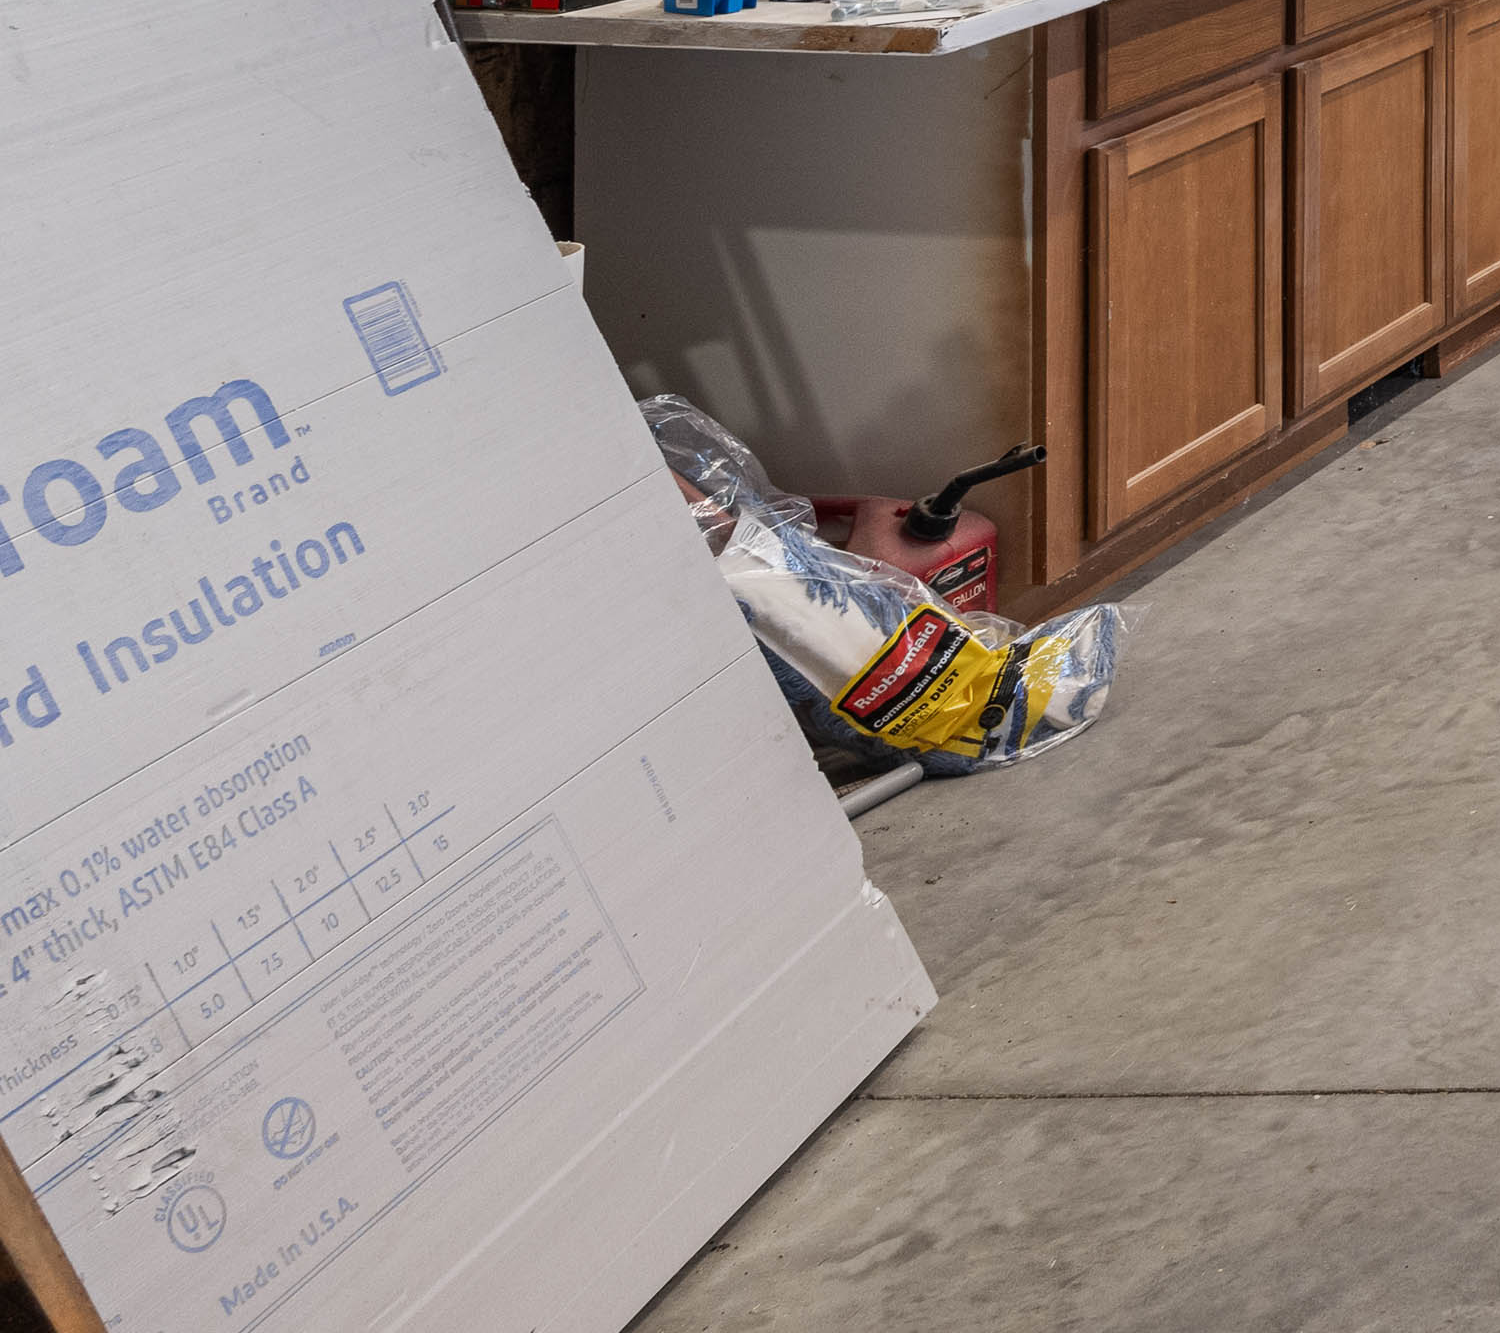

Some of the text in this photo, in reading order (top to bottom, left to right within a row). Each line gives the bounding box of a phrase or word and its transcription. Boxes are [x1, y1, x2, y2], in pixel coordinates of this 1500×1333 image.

[206, 456, 310, 525] Brand
[76, 521, 365, 695] Insulation
[952, 580, 986, 608] GALLON
[854, 621, 937, 710] Rubbermaid
[873, 676, 932, 729] Commercial
[889, 702, 929, 737] BLEND
[932, 669, 960, 702] DUST
[59, 845, 121, 897] 0.1%
[121, 804, 191, 860] water
[193, 734, 311, 817] absorption
[42, 906, 118, 963] thick,
[118, 854, 189, 918] ASTM
[188, 824, 237, 871] E84
[237, 790, 297, 838] Class
[297, 775, 318, 803] A
[199, 834, 450, 1020] 5.0 7.5 10 12.5 15
[176, 1202, 220, 1234] UL
[218, 1196, 359, 1316] Made in U.S.A.
